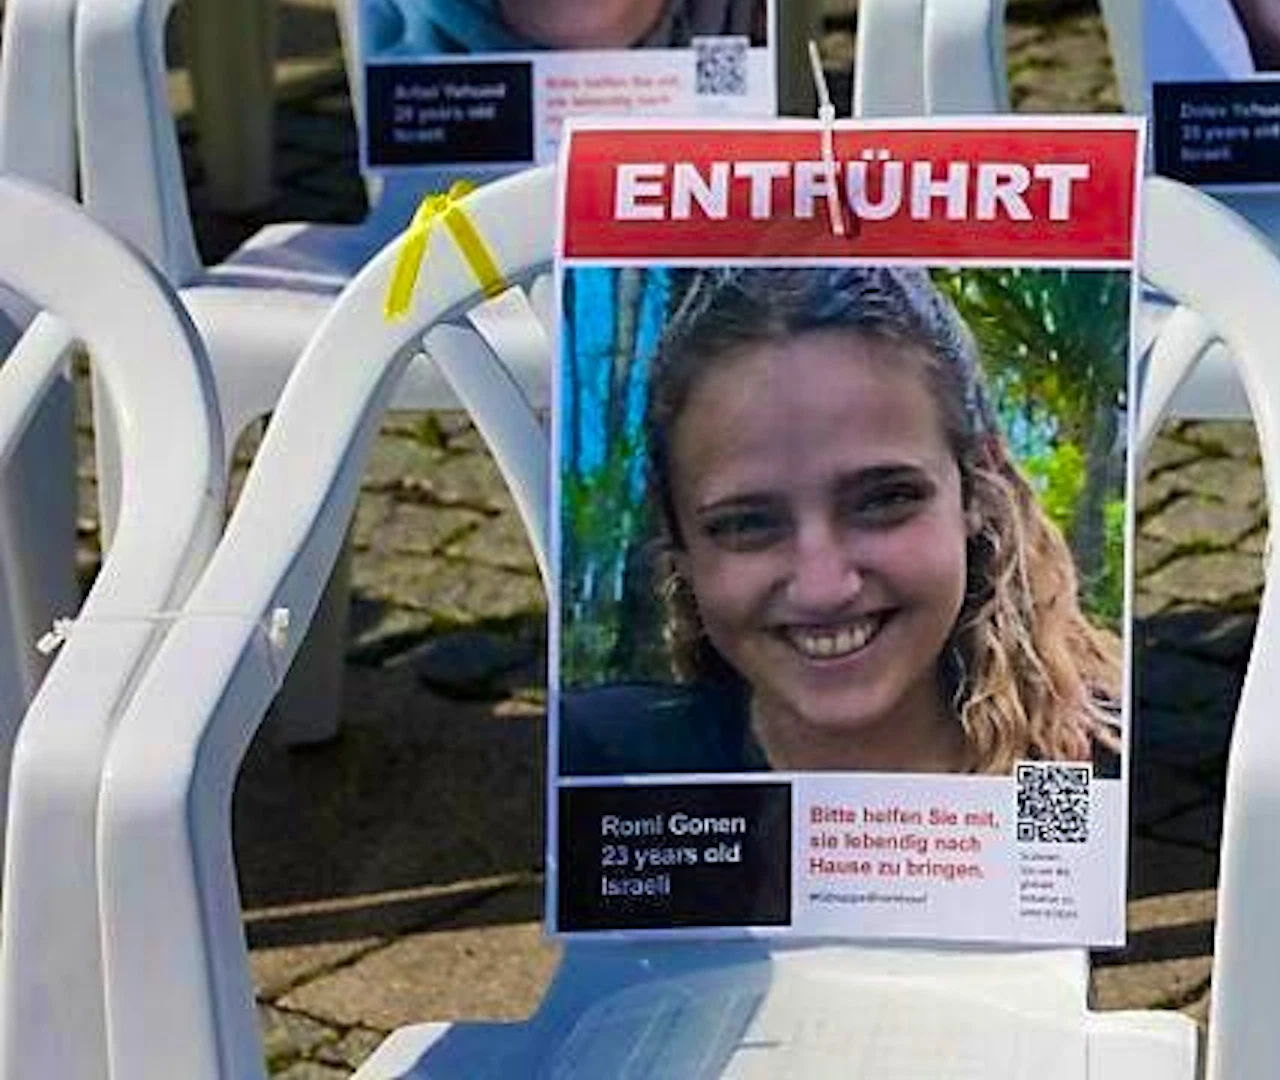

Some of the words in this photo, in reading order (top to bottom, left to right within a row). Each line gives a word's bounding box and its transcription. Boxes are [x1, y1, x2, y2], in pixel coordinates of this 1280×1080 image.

[614, 149, 1089, 220] ENTFÜHRT
[601, 814, 664, 837] Romi
[668, 813, 746, 835] Gonen
[810, 806, 856, 823] Bitte
[864, 806, 922, 824] helfen
[929, 808, 958, 825] Sie
[810, 832, 839, 848] sie
[844, 833, 928, 854] lebendig
[935, 836, 981, 852] nach
[601, 845, 629, 866] 23
[634, 847, 698, 871] years
[704, 841, 743, 863] old
[810, 857, 871, 875] Hause
[879, 862, 900, 875] zu
[601, 873, 671, 896] Israeli
